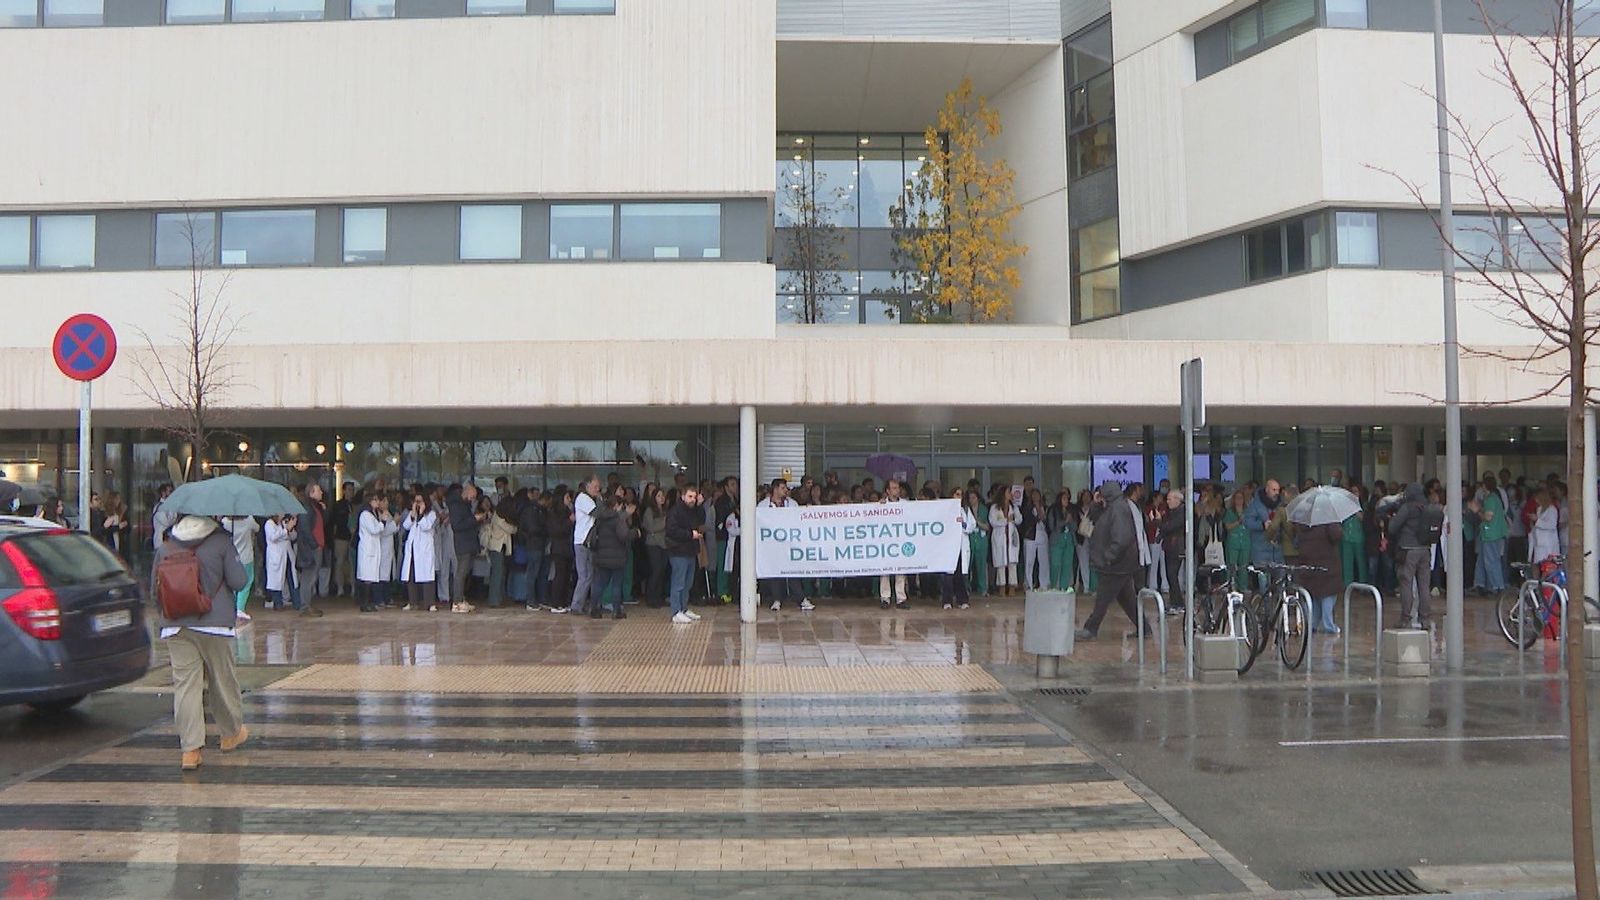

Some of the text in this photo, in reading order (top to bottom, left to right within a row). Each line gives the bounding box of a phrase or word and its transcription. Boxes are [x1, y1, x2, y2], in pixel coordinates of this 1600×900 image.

[800, 508, 904, 520] ¡SALVEMOS LA SANIDAD!
[760, 521, 945, 542] POR UN ESTATUTO
[790, 546, 829, 561] DEL
